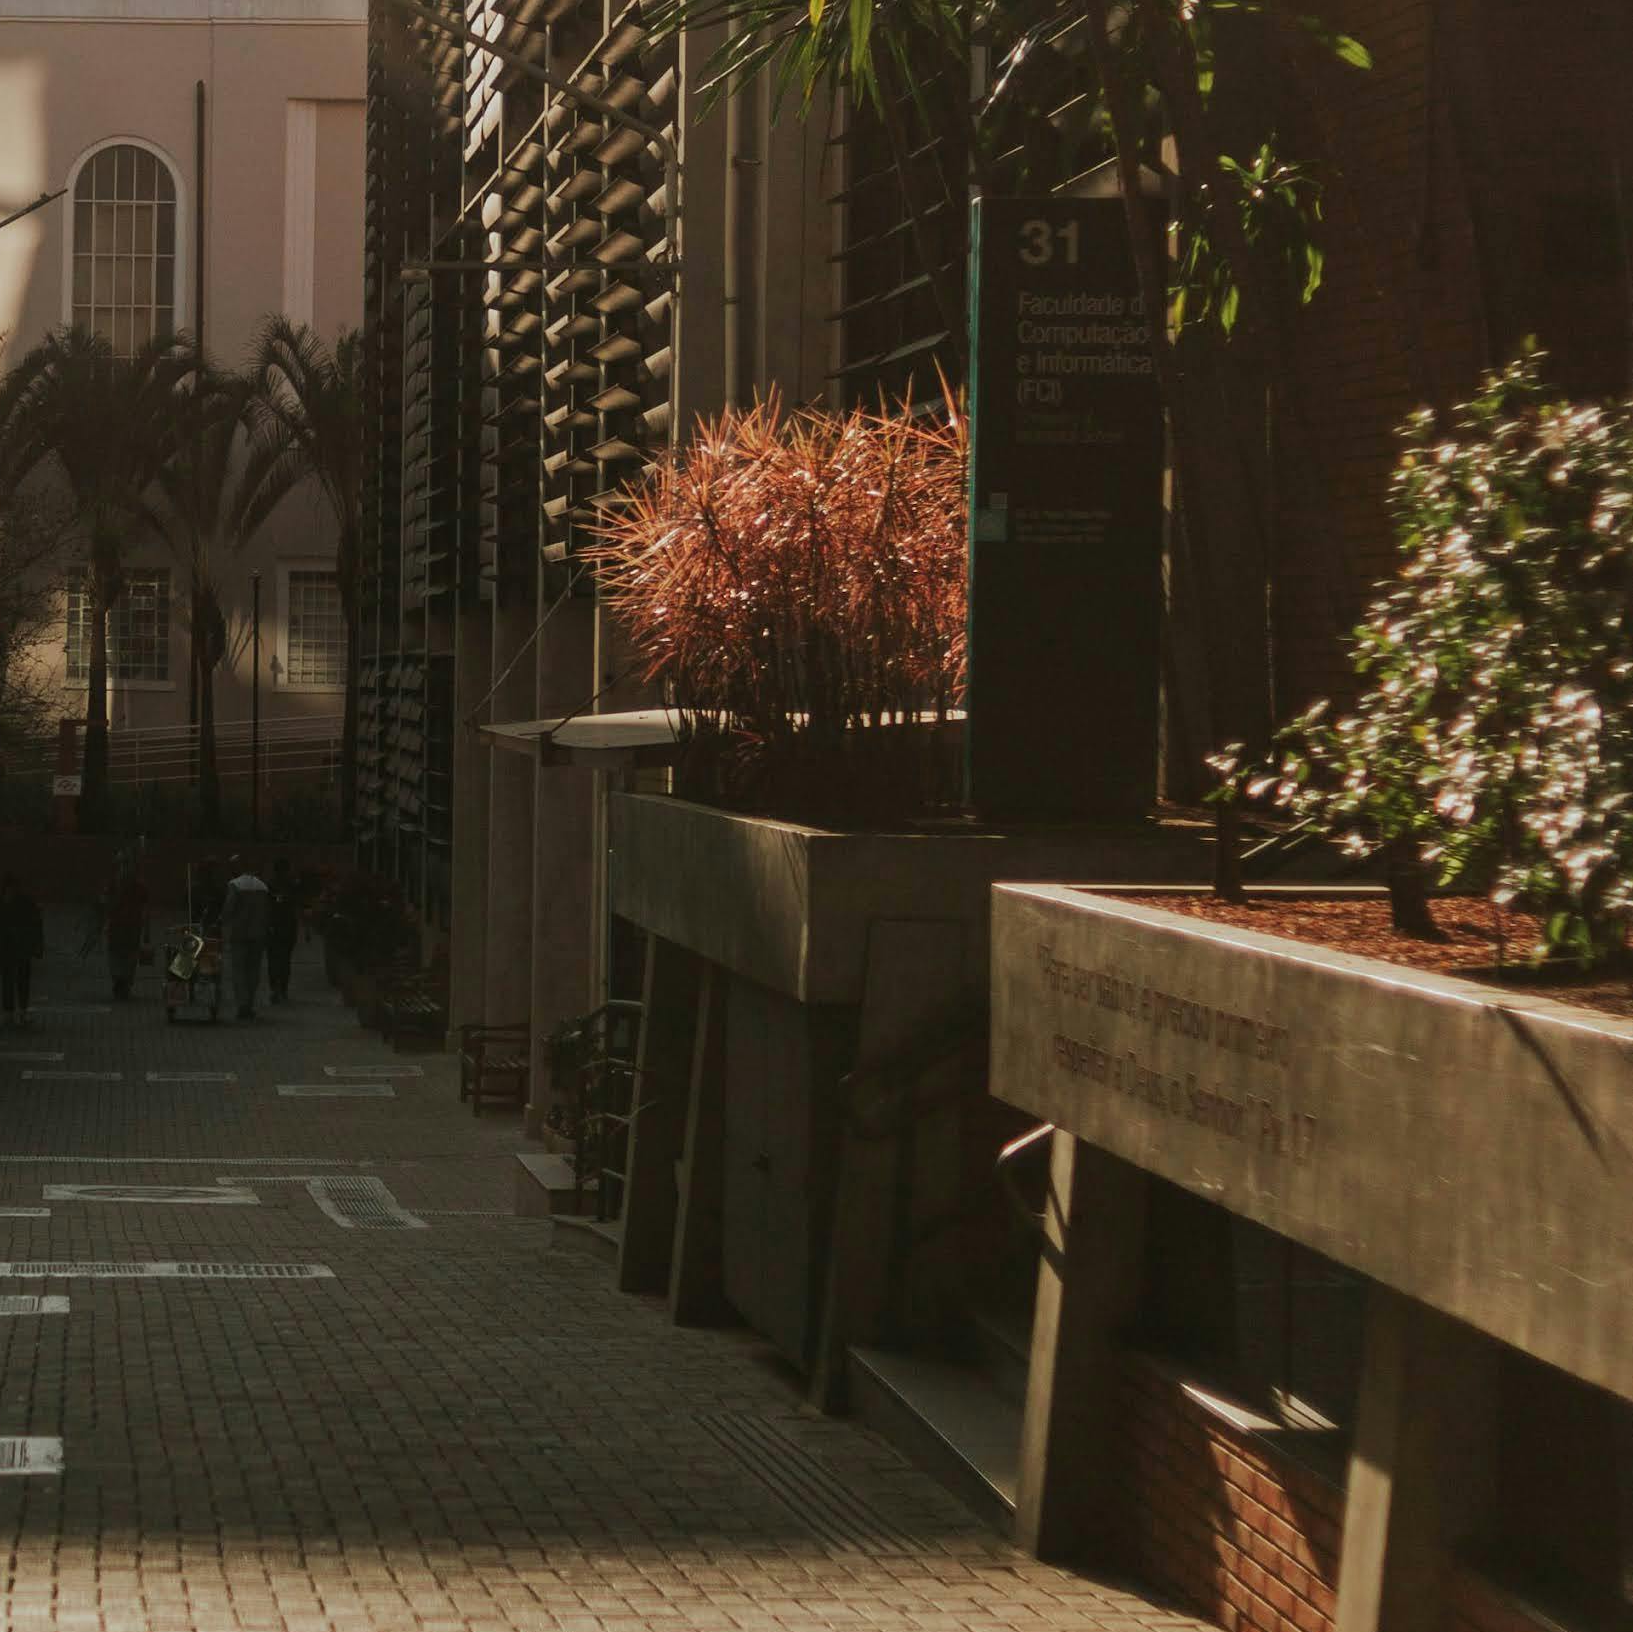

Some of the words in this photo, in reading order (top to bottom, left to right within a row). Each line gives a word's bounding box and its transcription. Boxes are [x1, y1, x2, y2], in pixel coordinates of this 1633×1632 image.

[1017, 219, 1079, 264] 31
[1018, 291, 1124, 315] Faculdade
[1017, 320, 1151, 350] Computação
[1016, 354, 1030, 374] e
[1036, 349, 1153, 374] Informática
[1017, 379, 1063, 406] (FCI)
